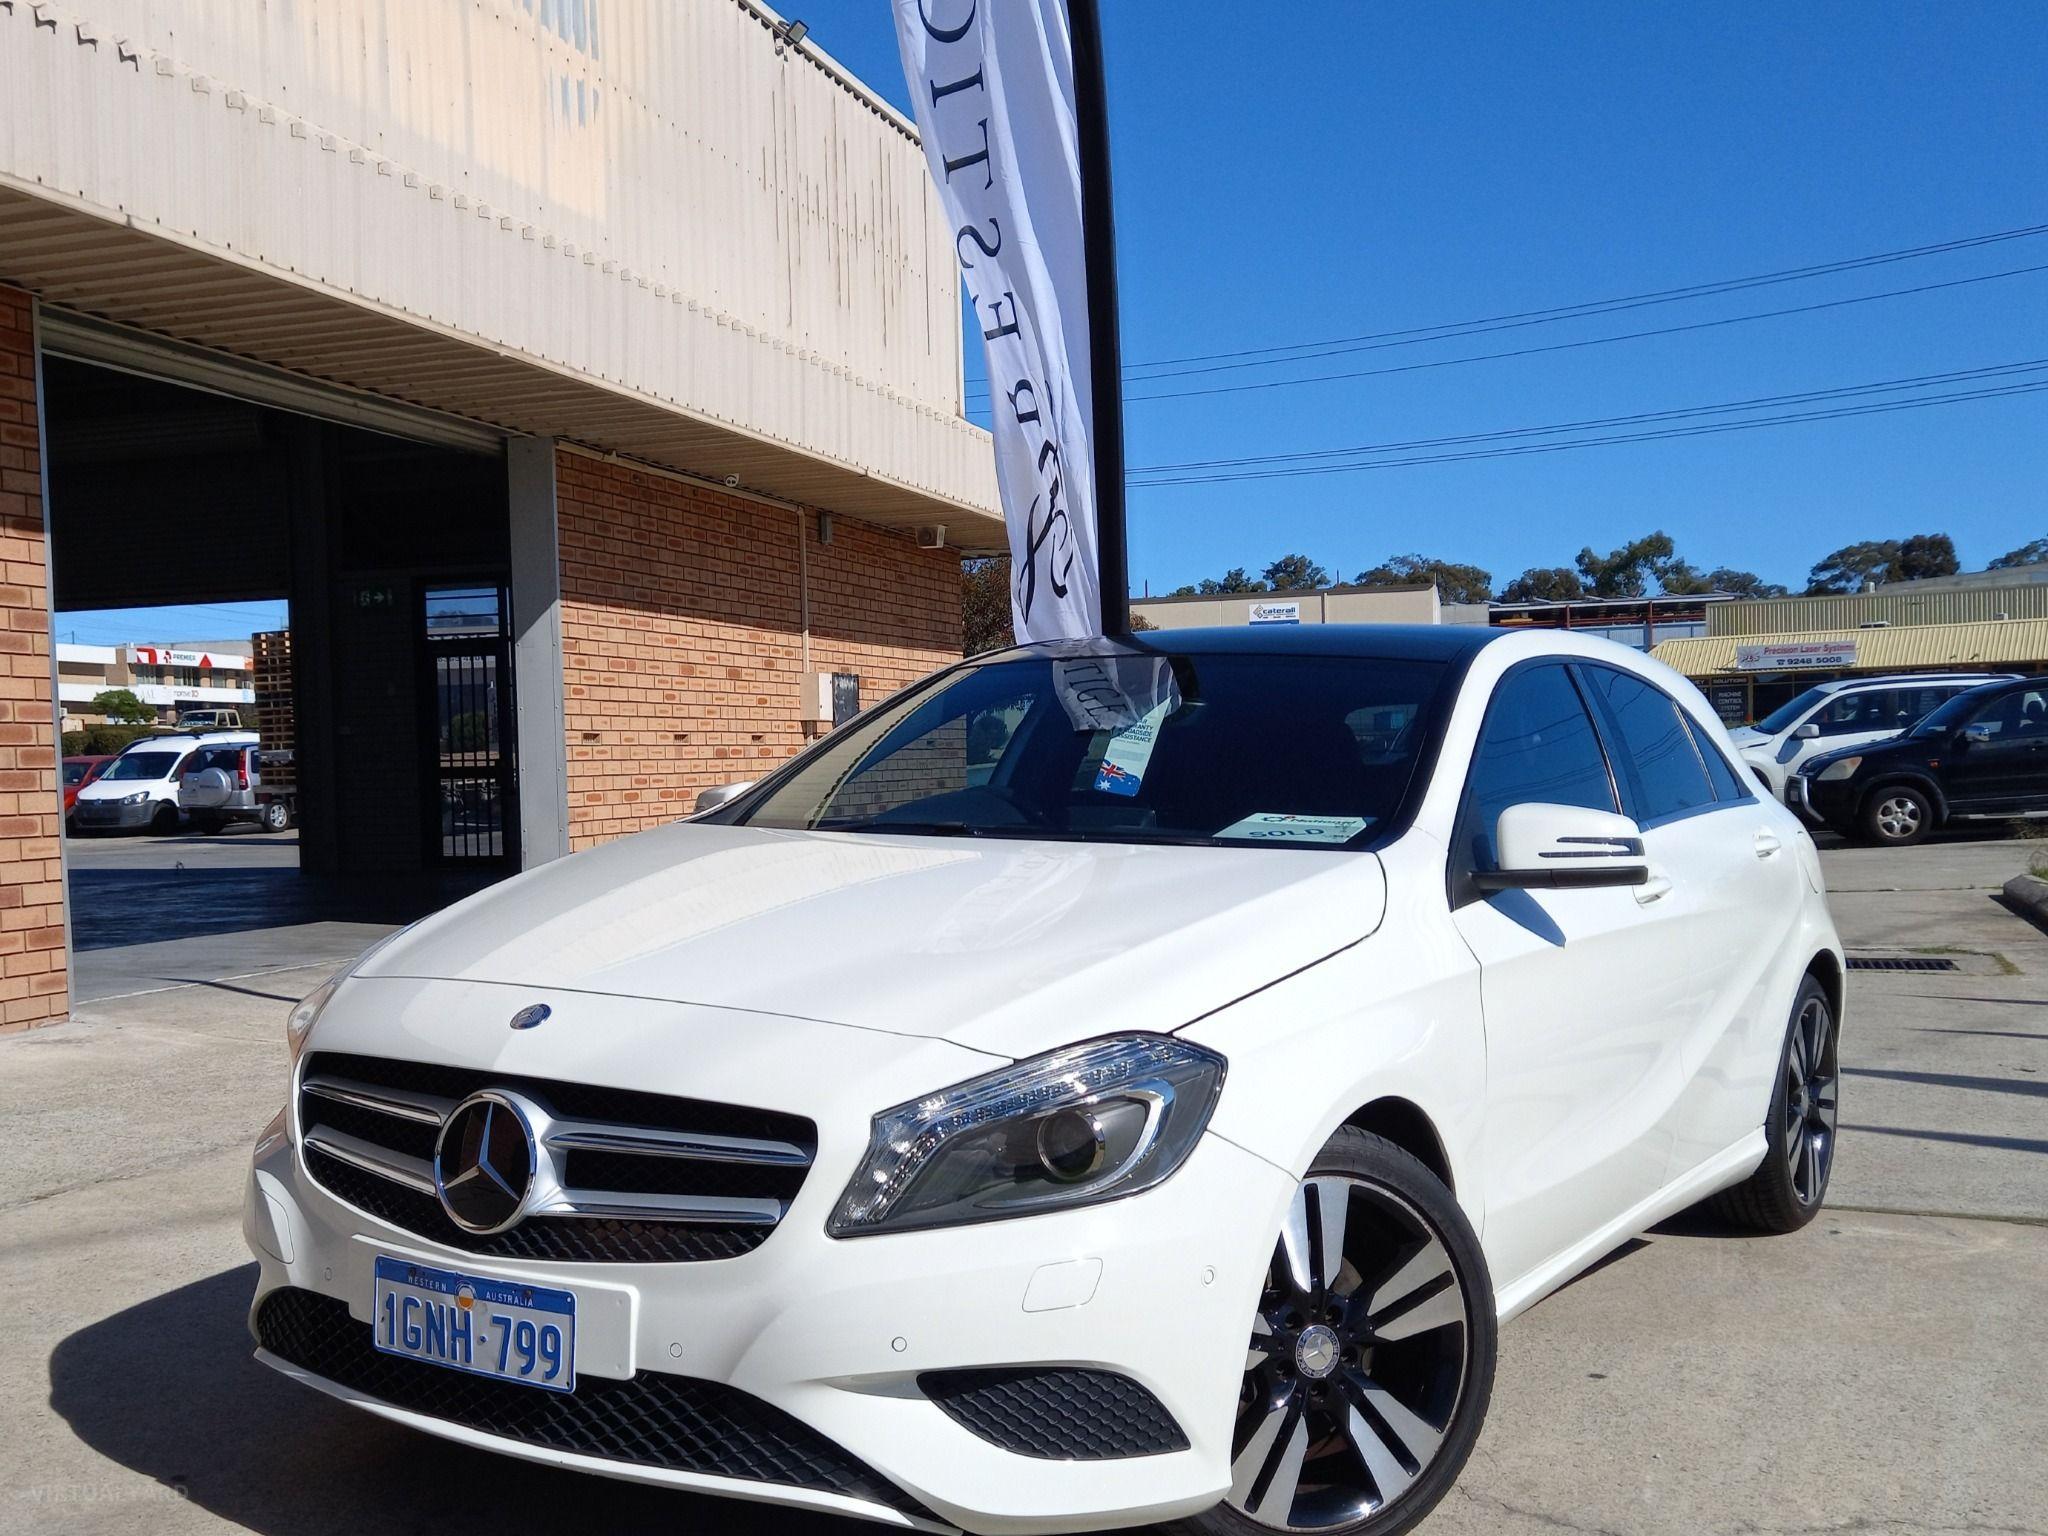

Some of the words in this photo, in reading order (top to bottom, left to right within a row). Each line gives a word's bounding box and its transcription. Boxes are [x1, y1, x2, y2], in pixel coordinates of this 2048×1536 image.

[1764, 646, 1798, 655] Precision
[1801, 645, 1821, 653] Laser
[1824, 643, 1855, 653] Systems
[1787, 657, 1812, 665] 9248
[1816, 656, 1842, 664] 5008
[1248, 828, 1325, 838] SOLD
[407, 1274, 447, 1292] WESTERN
[486, 1290, 534, 1308] AUSTRALIA
